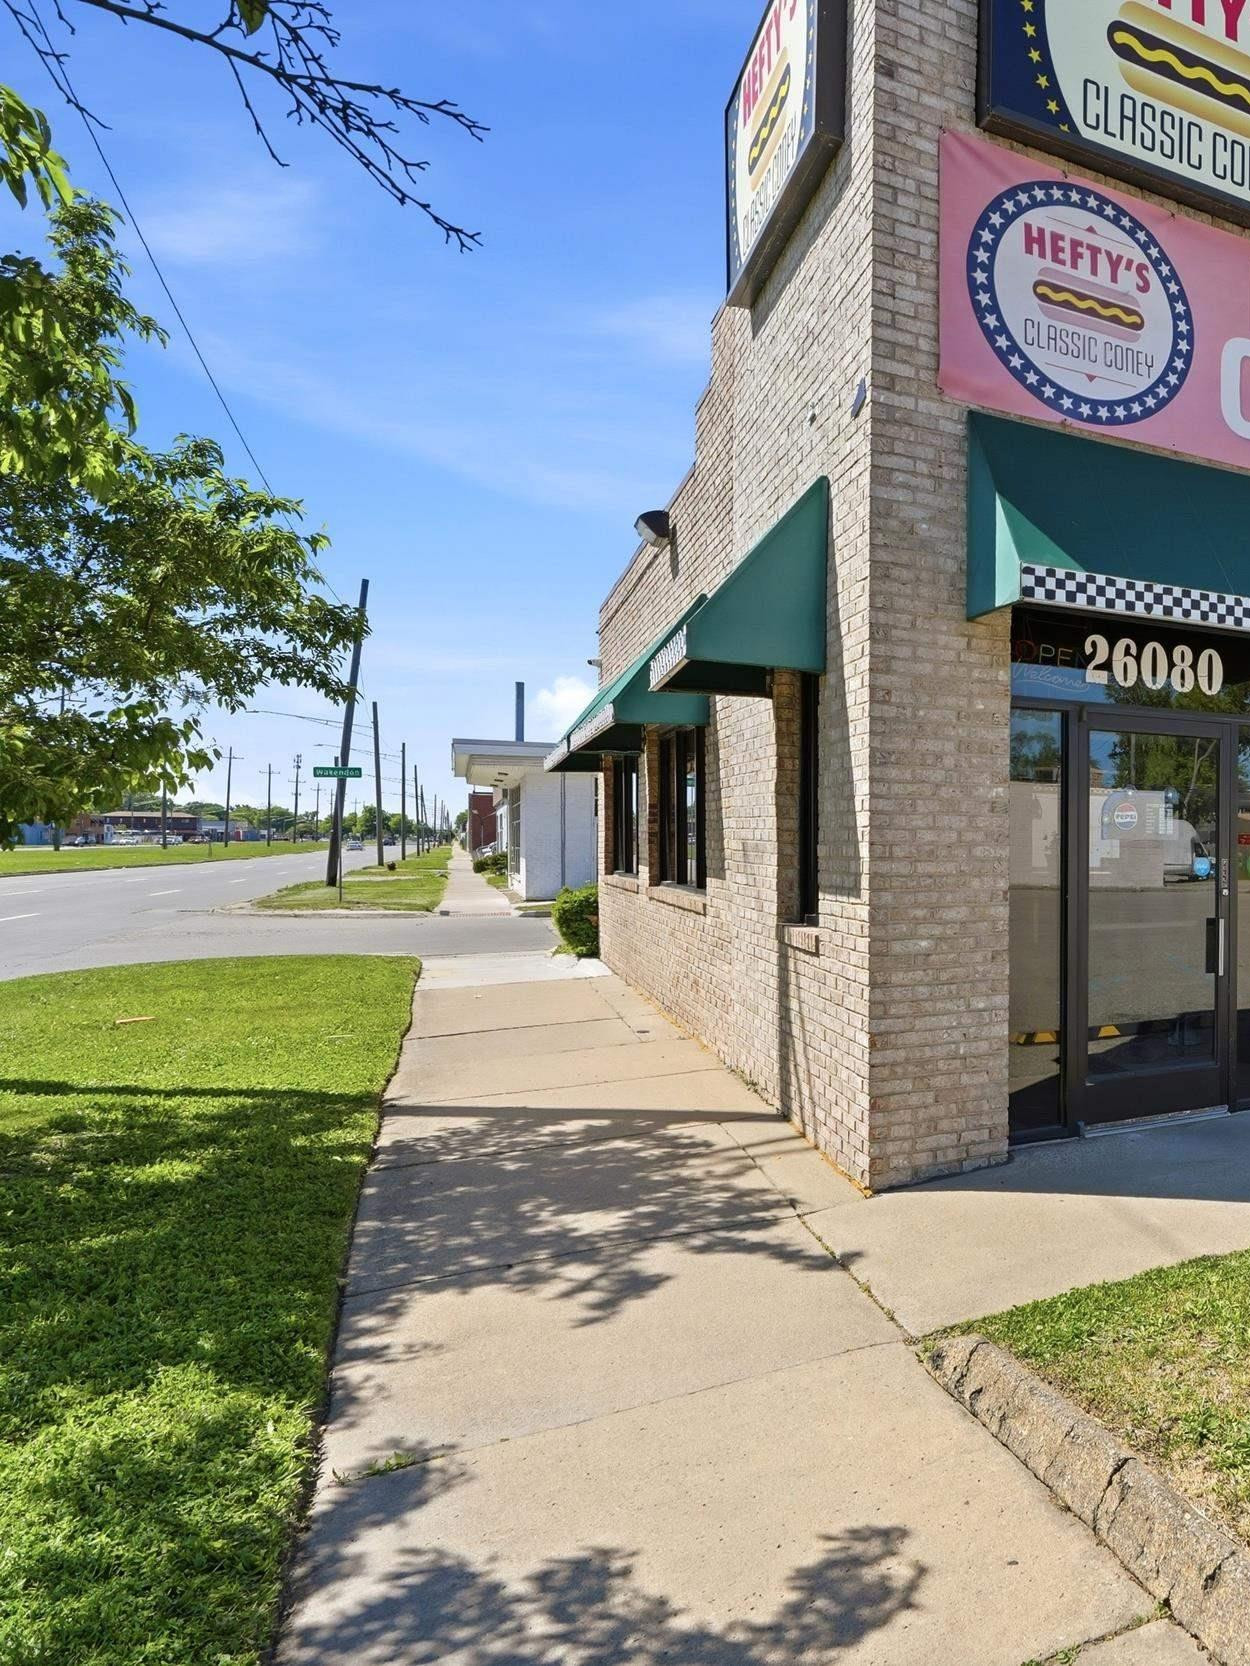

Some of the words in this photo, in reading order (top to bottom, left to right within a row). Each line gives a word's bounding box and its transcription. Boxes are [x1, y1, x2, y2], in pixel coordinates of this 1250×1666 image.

[1083, 78, 1202, 170] CLASSIC
[1023, 222, 1151, 294] HEFTY'S
[1024, 318, 1098, 363] CLASSIC
[1104, 341, 1154, 379] CONEY
[1084, 634, 1223, 695] 26080
